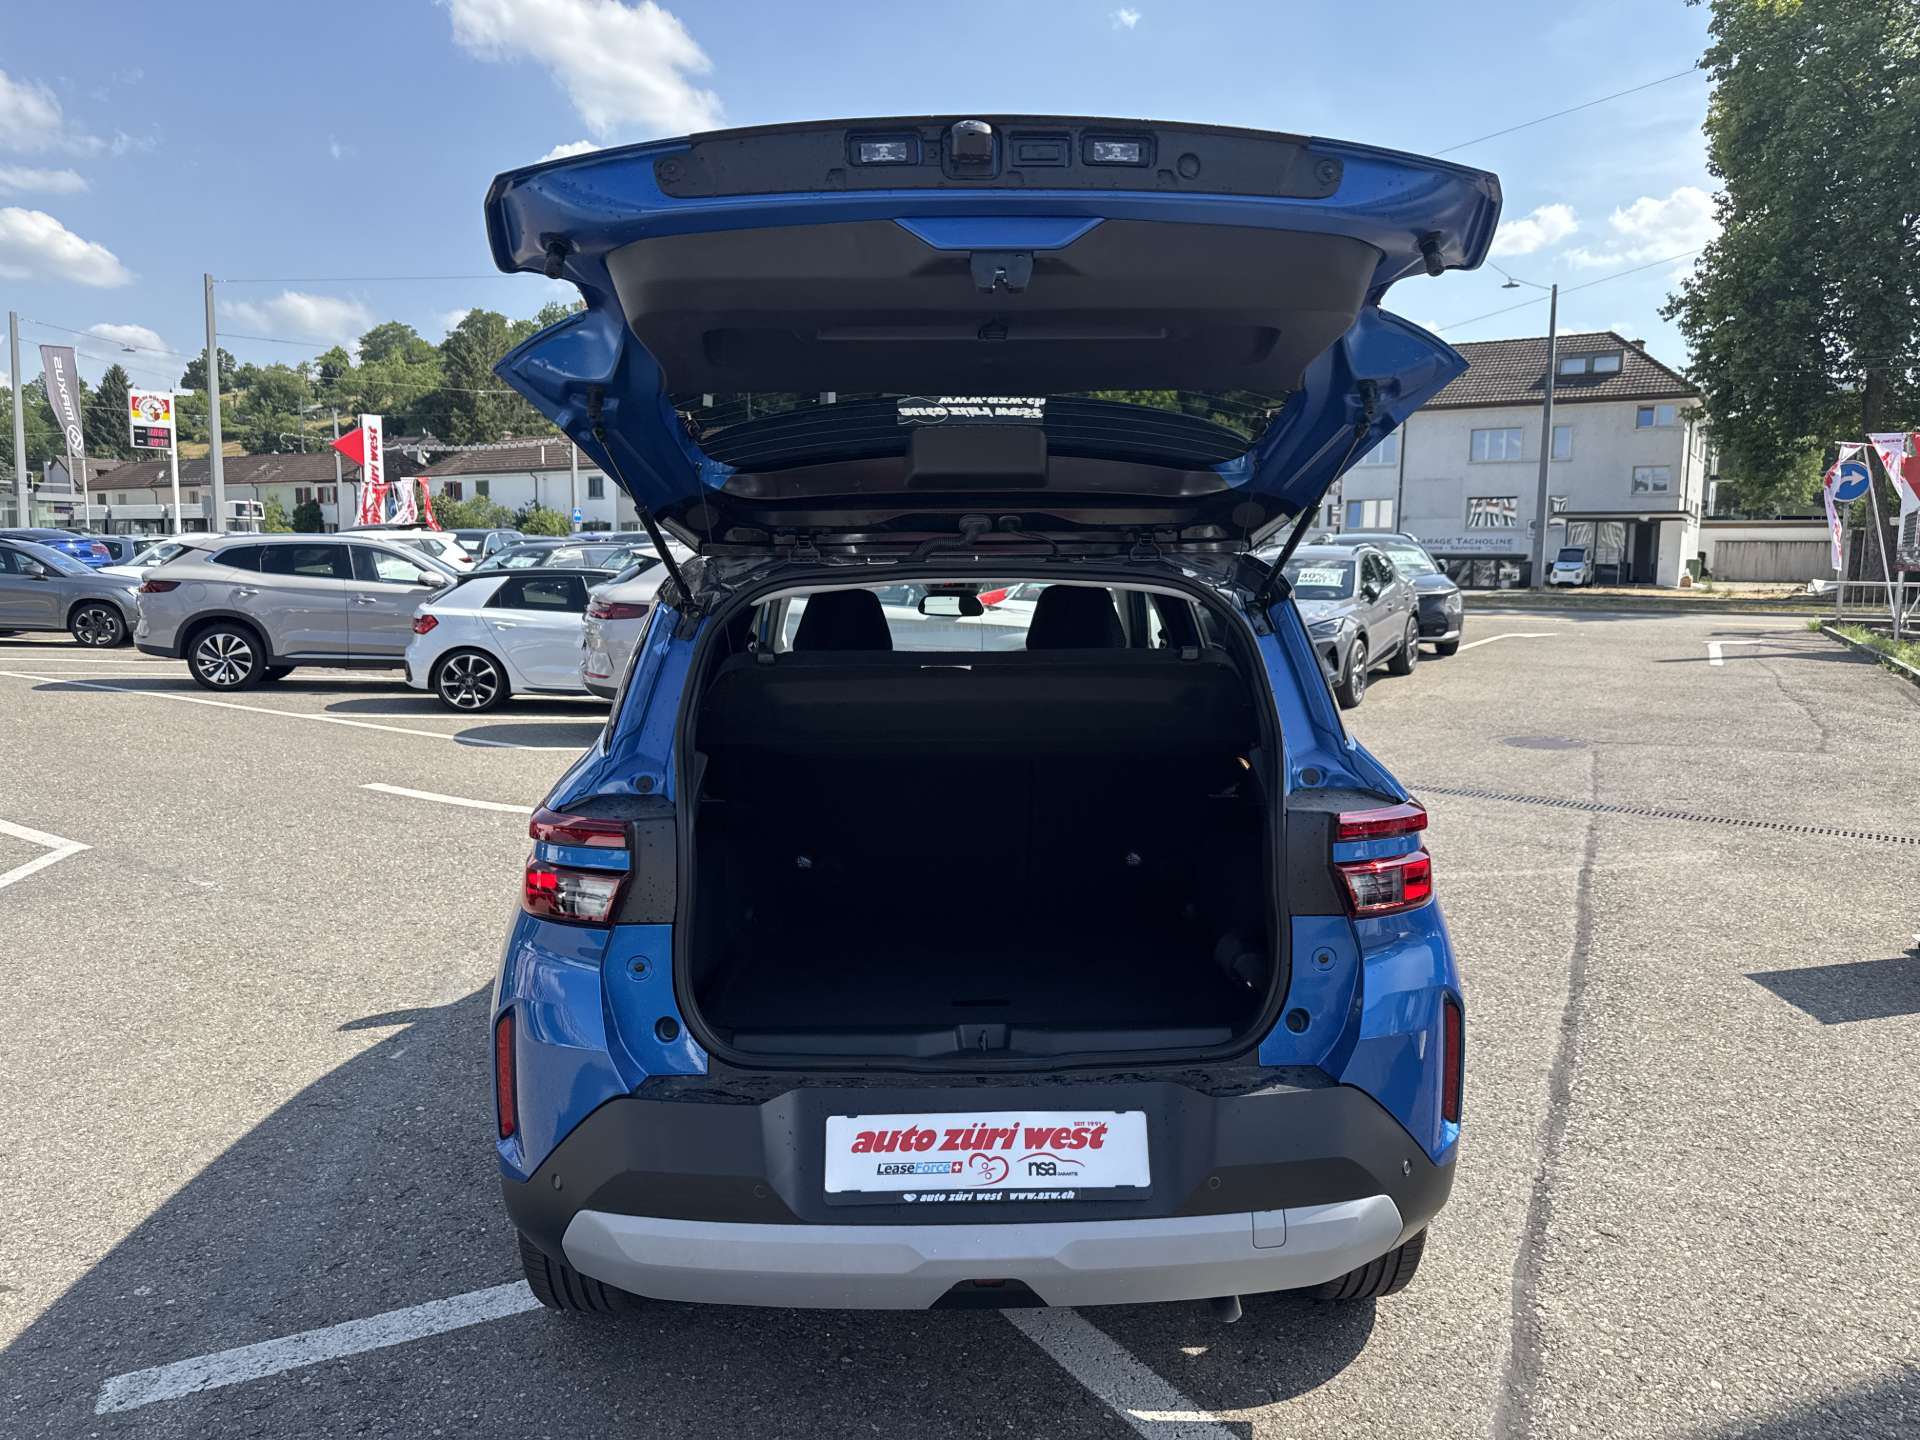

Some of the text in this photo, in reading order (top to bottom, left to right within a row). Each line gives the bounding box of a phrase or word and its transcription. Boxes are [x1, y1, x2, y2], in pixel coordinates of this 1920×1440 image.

[368, 426, 378, 461] west
[851, 1122, 1108, 1154] auto züri west
[876, 1161, 951, 1175] LeaseForce
[1028, 1161, 1057, 1177] nsa
[919, 1190, 1076, 1202] auto züri west www.azw.ch
